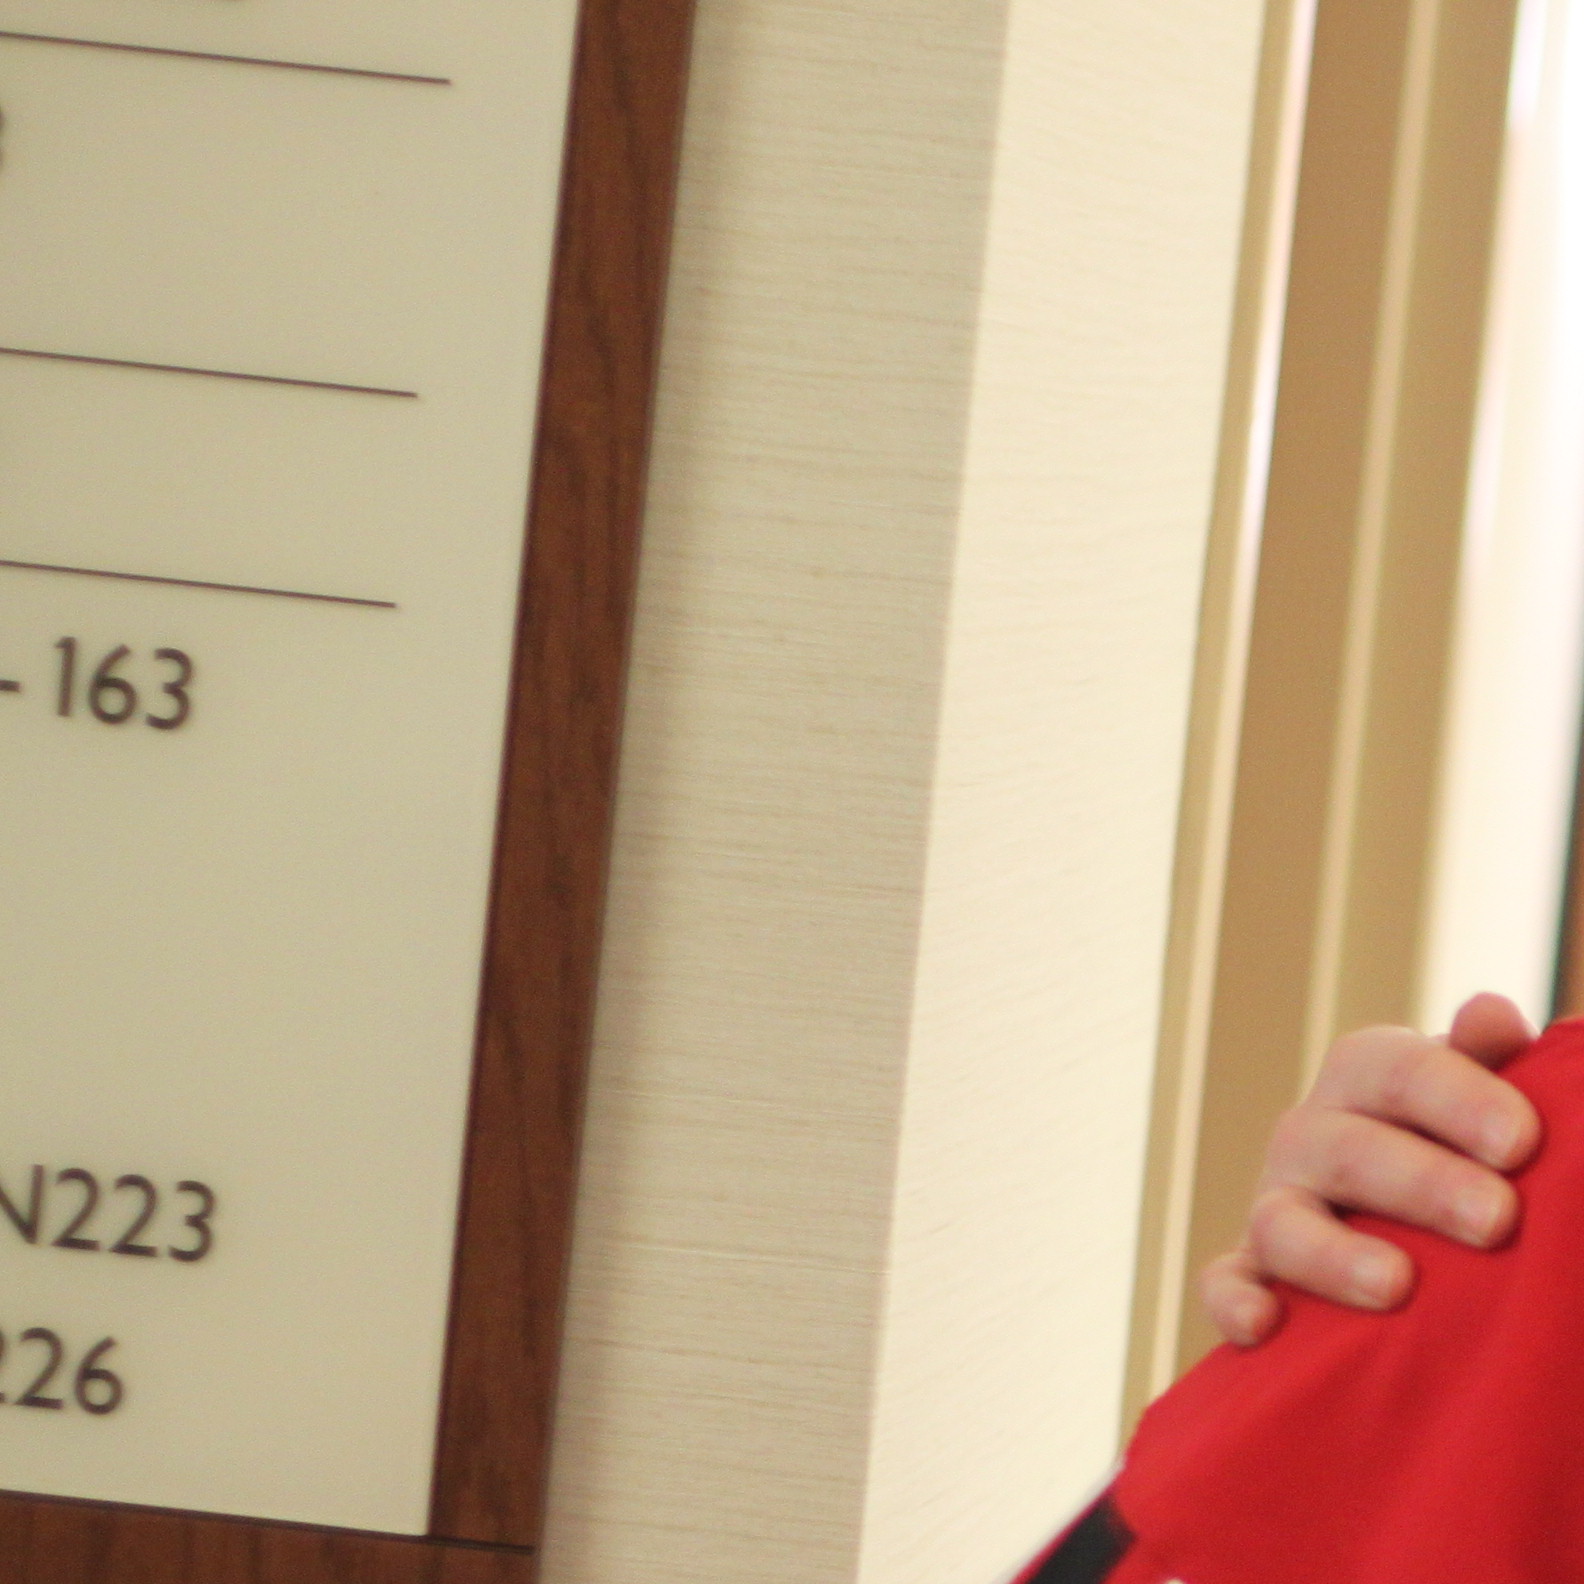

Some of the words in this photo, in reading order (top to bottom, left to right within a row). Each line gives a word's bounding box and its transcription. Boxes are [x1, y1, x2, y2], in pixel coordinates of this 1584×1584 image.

[55, 636, 193, 730] 163
[0, 1164, 216, 1263] N223
[0, 1327, 124, 1416] 26
